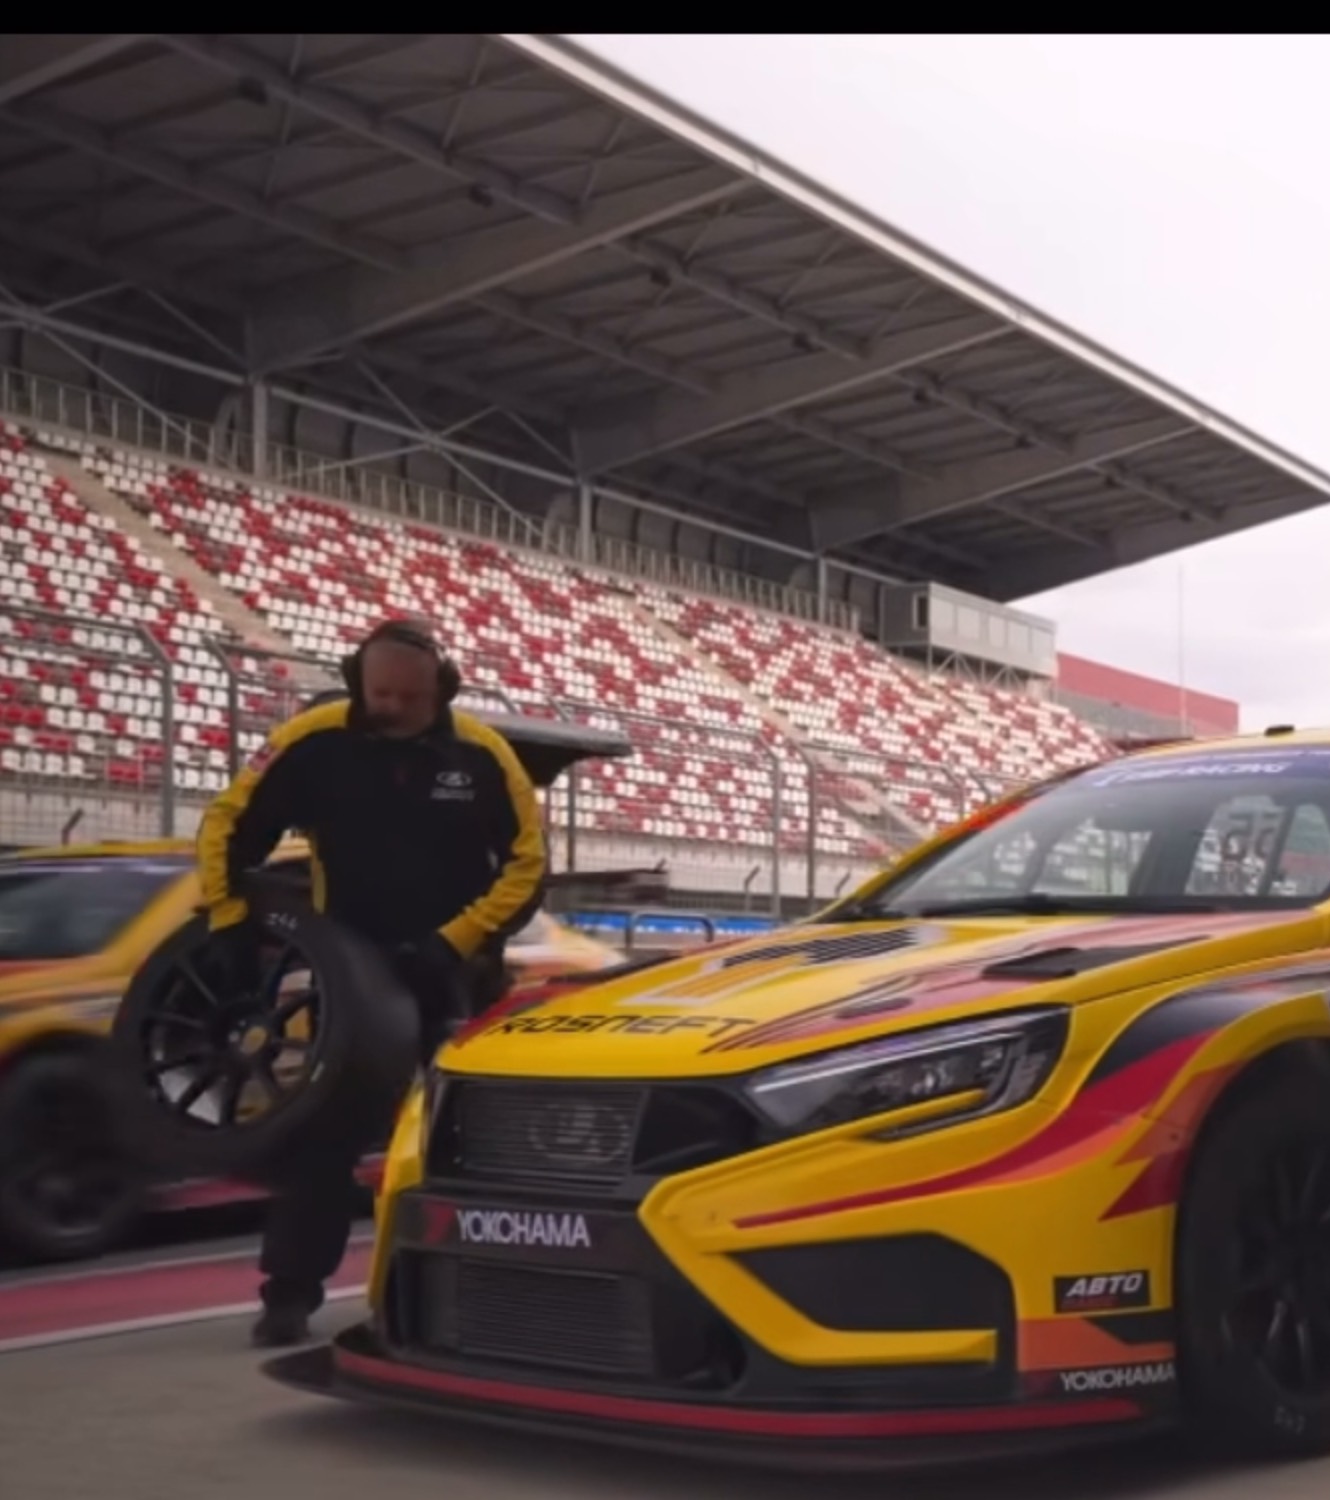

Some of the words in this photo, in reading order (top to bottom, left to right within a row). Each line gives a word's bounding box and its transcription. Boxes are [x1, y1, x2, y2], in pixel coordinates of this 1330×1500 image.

[484, 1014, 758, 1038] ROSNEFT
[456, 1209, 592, 1247] YOKOHAMA
[1060, 1362, 1176, 1392] YOKOHAMA
